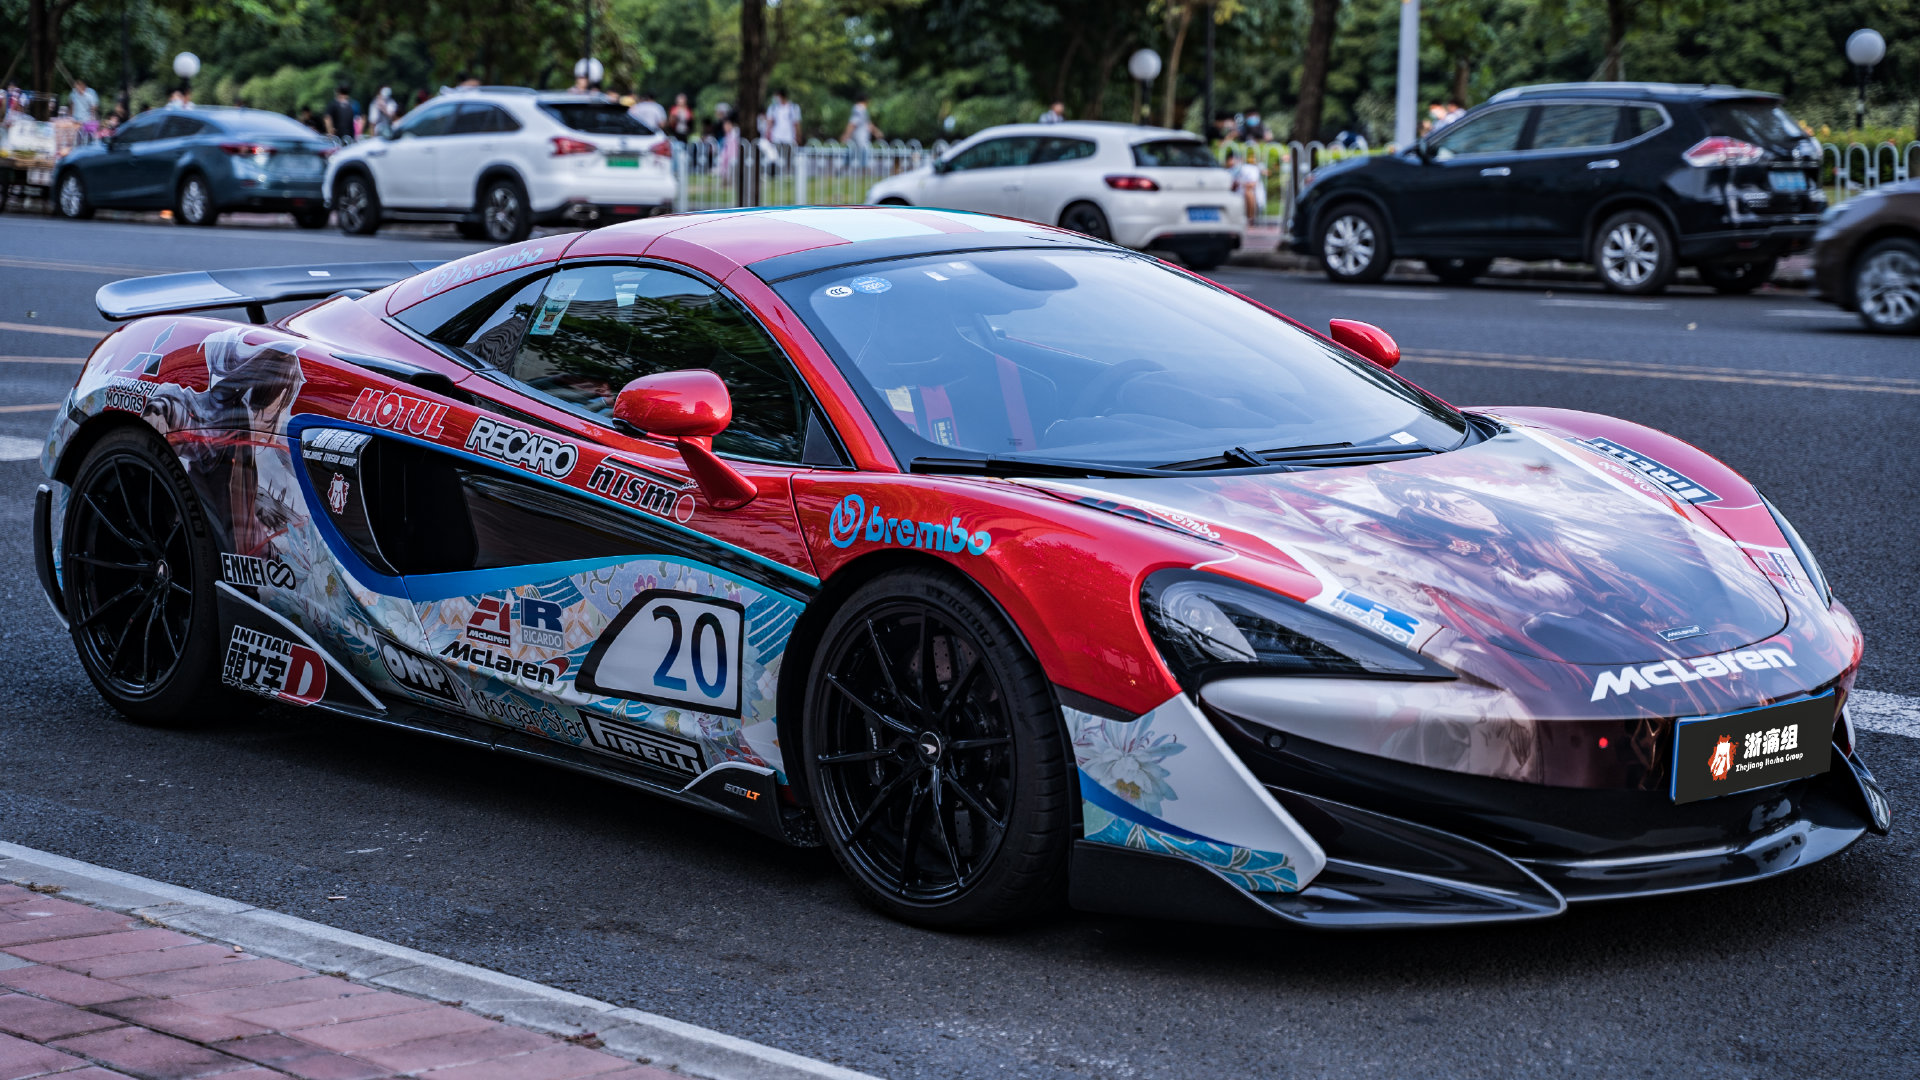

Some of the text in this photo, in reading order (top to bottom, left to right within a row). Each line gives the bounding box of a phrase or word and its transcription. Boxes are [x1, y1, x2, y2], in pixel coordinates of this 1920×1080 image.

[452, 247, 544, 284] brembo
[105, 391, 144, 412] MOTORS
[348, 386, 450, 439] MOTUL
[465, 416, 579, 480] RECARO
[587, 464, 695, 523] nismo
[865, 506, 991, 556] brembo
[1144, 505, 1221, 539] rembo
[223, 554, 266, 586] ENKEI
[232, 626, 291, 656] INITIAL
[468, 629, 510, 645] McLaren
[523, 629, 562, 648] RICARDO
[1335, 602, 1408, 642] RICARDO
[383, 645, 446, 691] OMP
[439, 641, 556, 685] McLaren
[652, 604, 728, 699] 20
[284, 644, 326, 702] D
[1590, 648, 1797, 702] McLaren
[587, 715, 701, 775] PIRELLI
[1744, 724, 1798, 759] 浙痛组
[1735, 761, 1764, 772] Zhejiang
[1785, 752, 1804, 761] Group
[724, 782, 761, 801] 600LT
